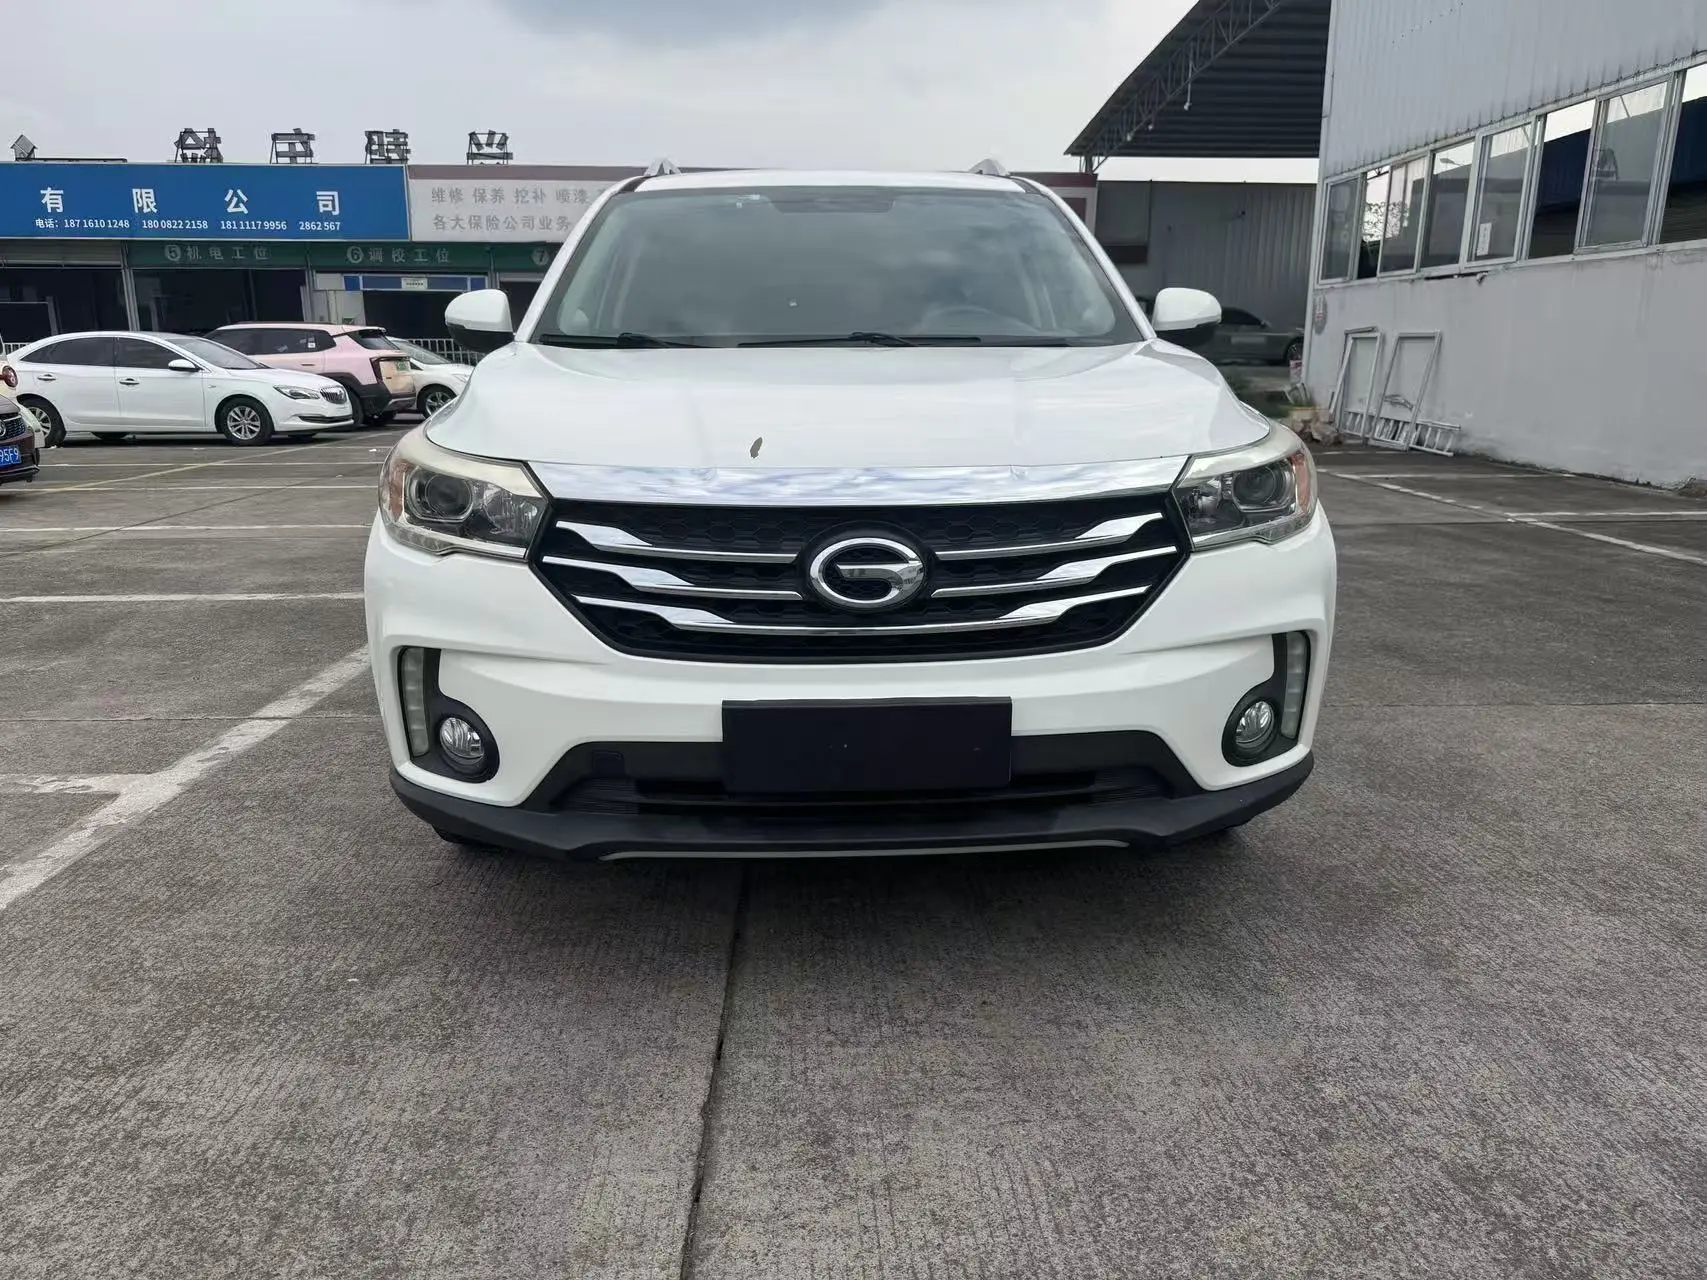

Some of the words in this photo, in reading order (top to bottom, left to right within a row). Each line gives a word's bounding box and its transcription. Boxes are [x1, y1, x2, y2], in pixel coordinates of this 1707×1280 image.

[40, 186, 341, 216] 有限公司
[431, 187, 464, 204] 维修
[472, 187, 505, 204] 保养
[514, 187, 547, 204] 挖补
[432, 214, 572, 233] 各大保险公司业务
